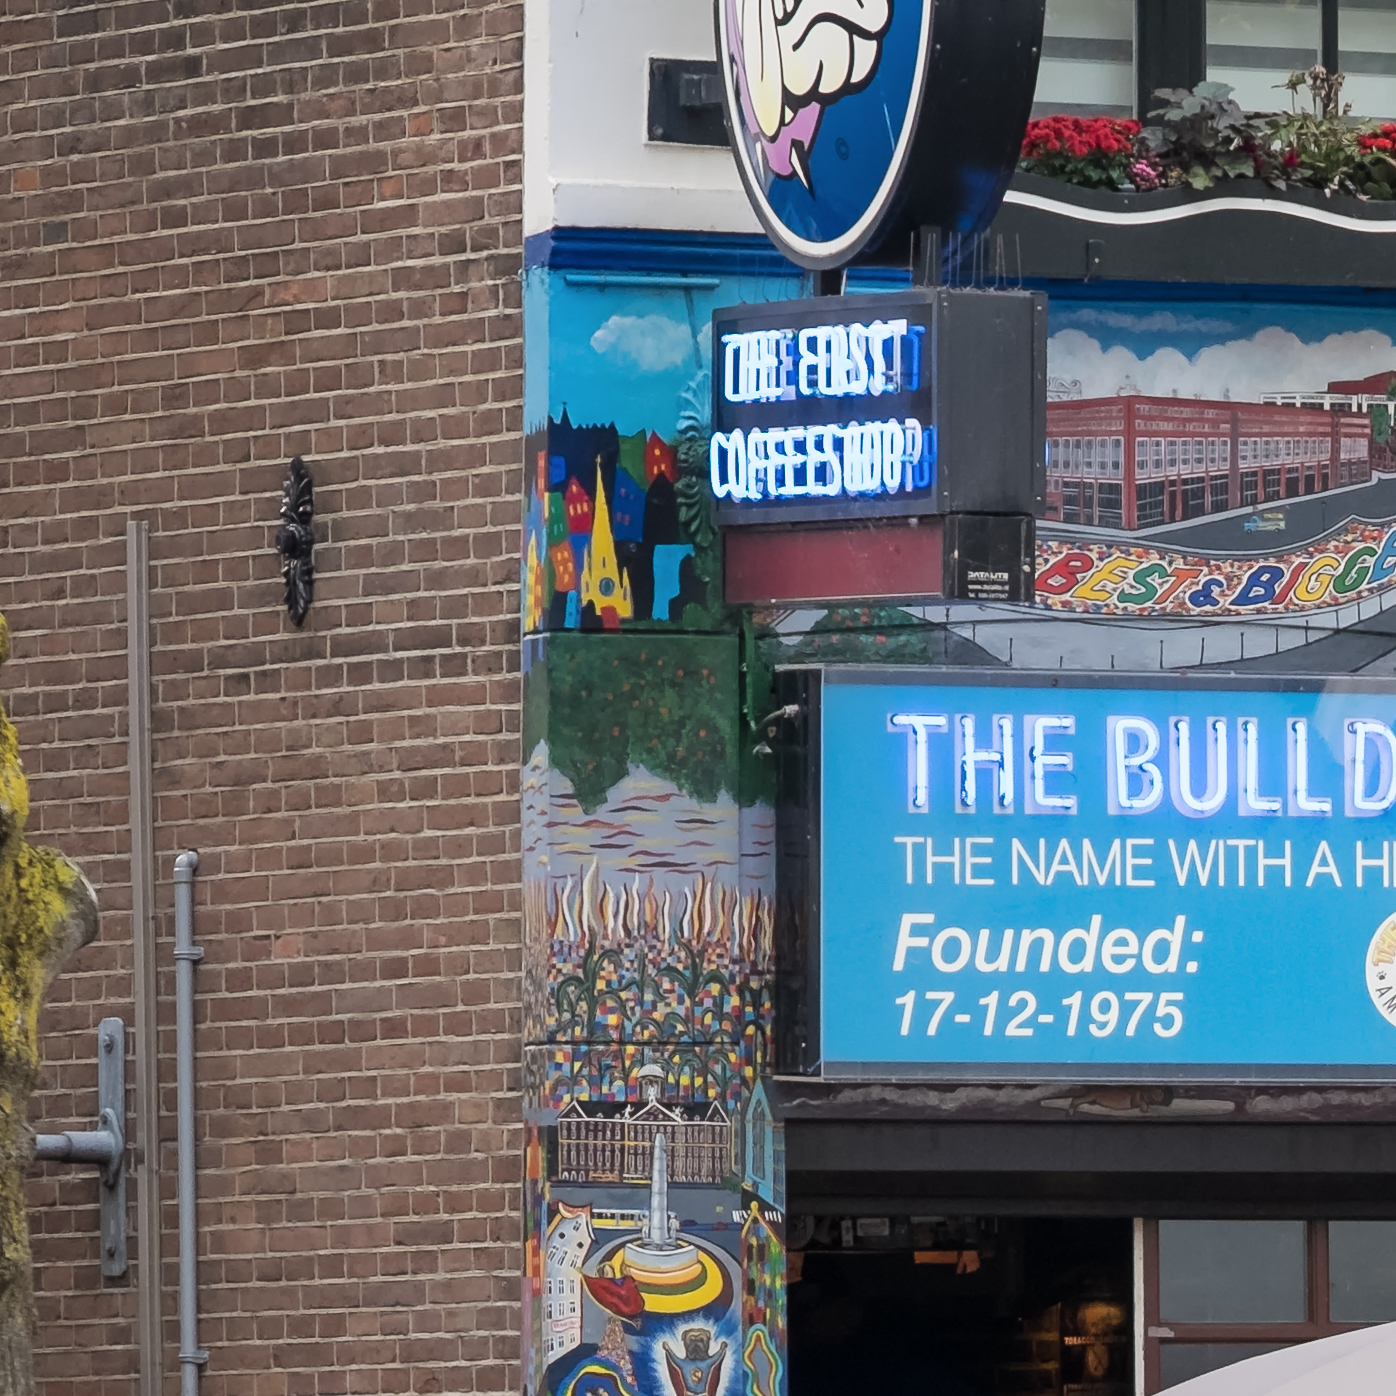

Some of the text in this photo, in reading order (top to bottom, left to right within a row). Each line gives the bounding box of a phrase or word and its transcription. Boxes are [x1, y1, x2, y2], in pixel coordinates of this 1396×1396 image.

[721, 318, 912, 403] THE FIRST
[1036, 550, 1202, 611] BEST
[886, 712, 1077, 816] THE
[894, 837, 994, 887] THE
[1011, 837, 1156, 887] NAME
[1168, 838, 1292, 888] WITH
[1305, 841, 1345, 889] A
[892, 913, 1204, 974] Founded:
[894, 990, 1186, 1038] 17-12-1975
